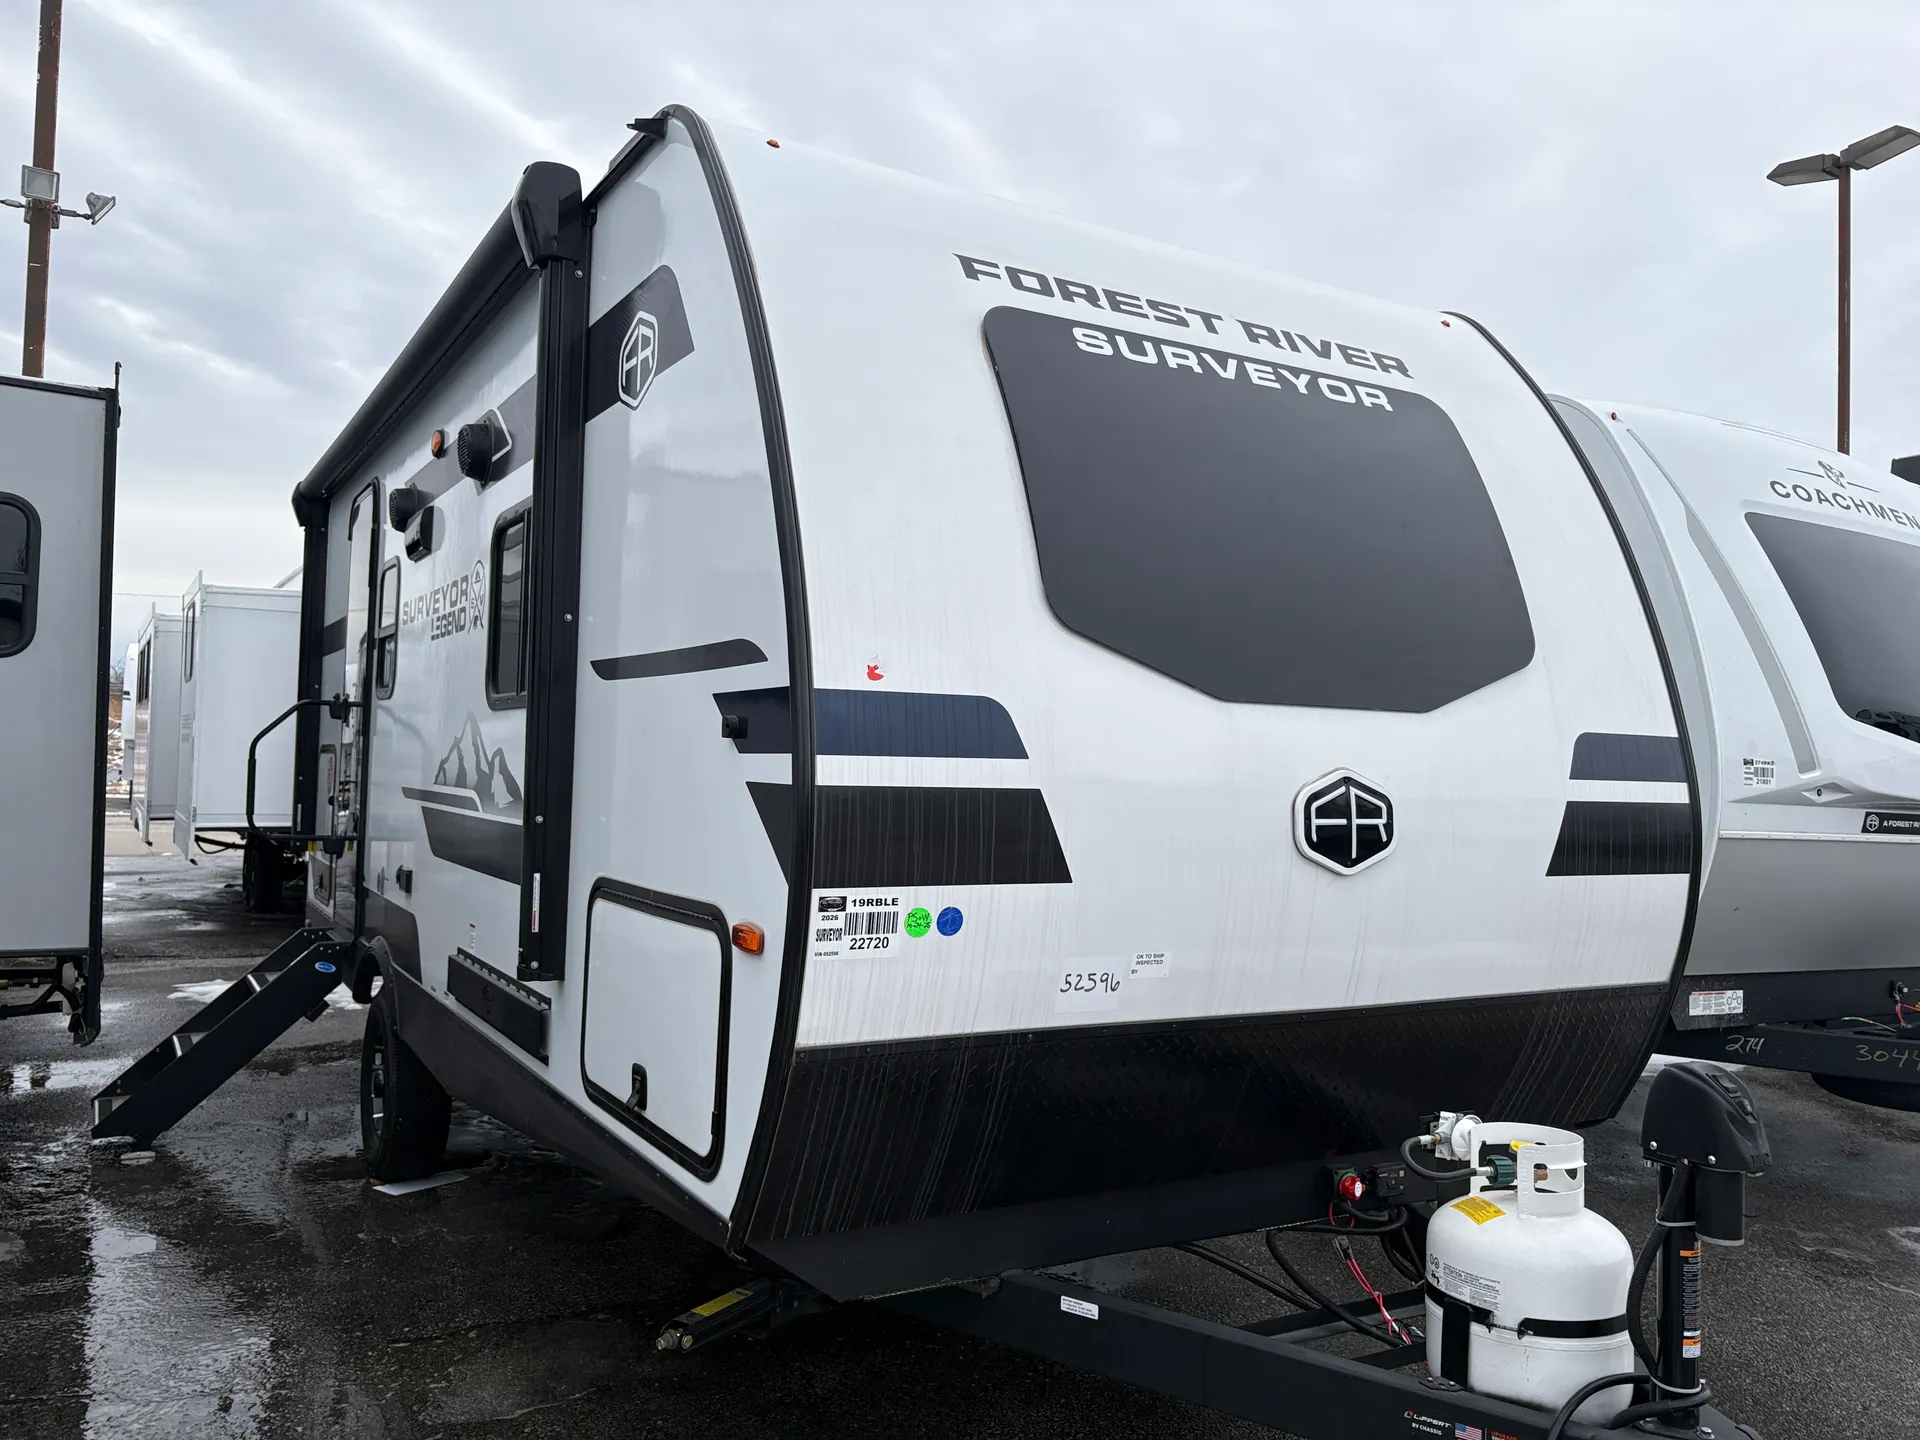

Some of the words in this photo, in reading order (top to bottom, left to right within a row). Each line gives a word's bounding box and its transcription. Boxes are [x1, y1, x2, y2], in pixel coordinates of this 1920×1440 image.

[952, 253, 1224, 335] FOREST
[1235, 318, 1415, 379] RIVER
[1072, 326, 1394, 412] SURVEYOR
[402, 574, 469, 626] SURVEYOR
[430, 606, 467, 641] LEGEND
[1889, 820, 1913, 828] FOREST
[851, 897, 899, 907] 19RBLE
[815, 927, 843, 942] SURVEYOR
[849, 936, 889, 950] 22720
[1060, 972, 1121, 993] 52596
[1419, 1424, 1442, 1435] CHASSIS
